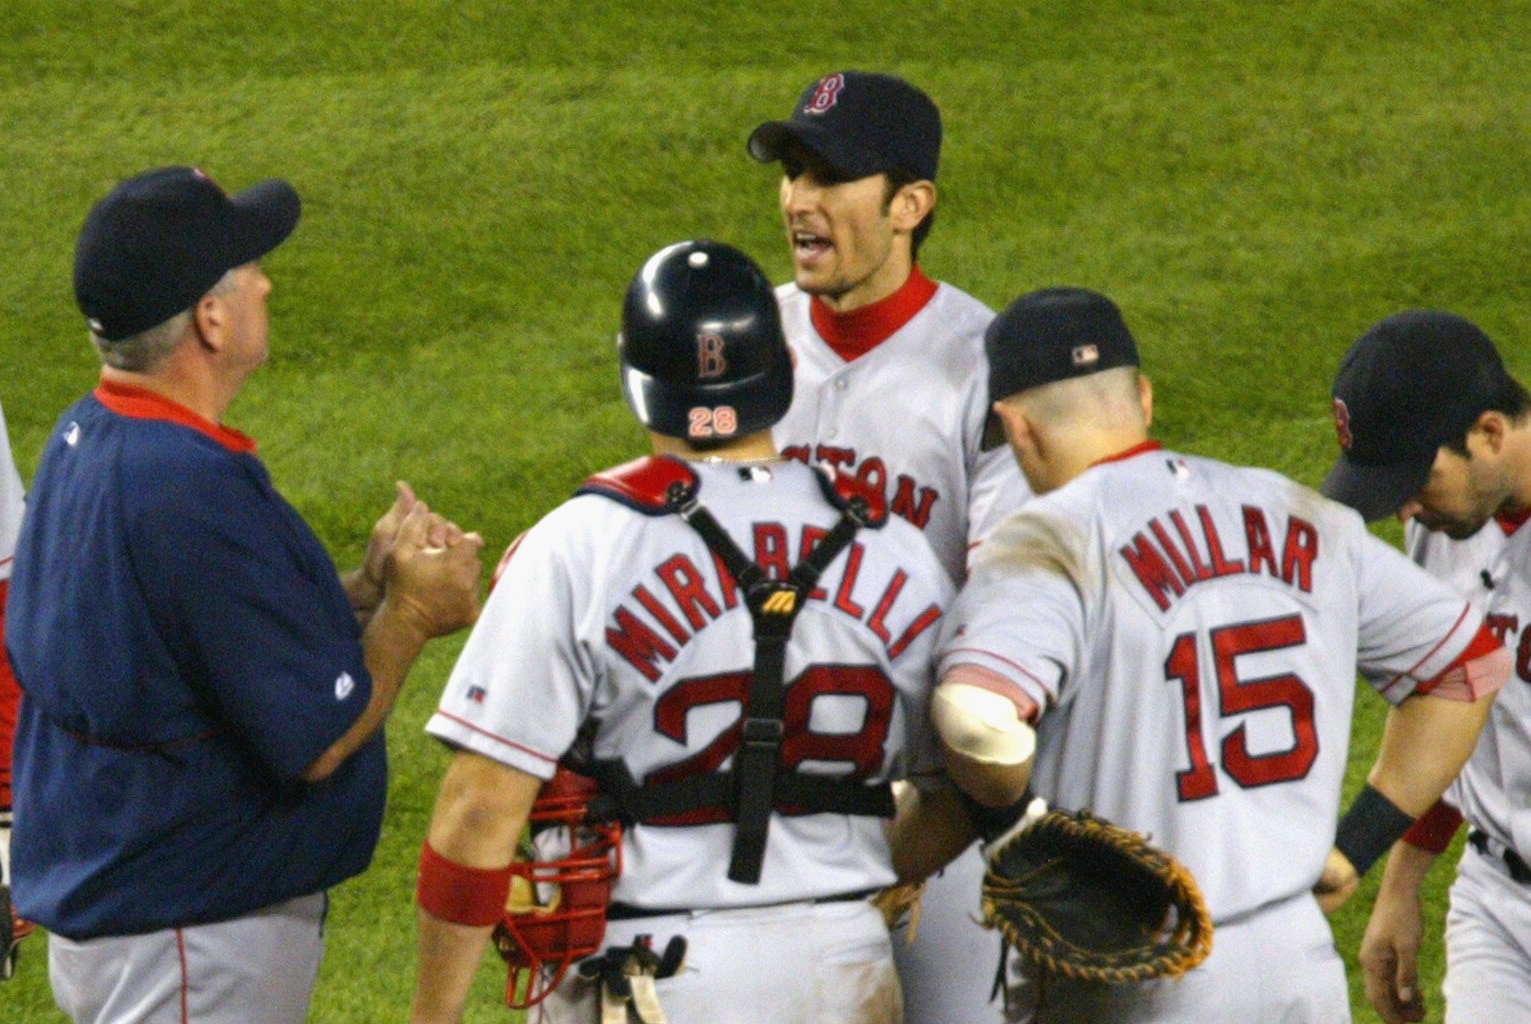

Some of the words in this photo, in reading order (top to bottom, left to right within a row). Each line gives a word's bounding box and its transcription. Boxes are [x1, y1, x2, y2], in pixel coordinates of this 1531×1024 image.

[803, 73, 845, 115] B
[697, 333, 726, 378] B
[688, 405, 737, 437] 28
[1118, 503, 1319, 612] MILLAR
[643, 663, 896, 828] 28
[1163, 611, 1319, 803] 15
